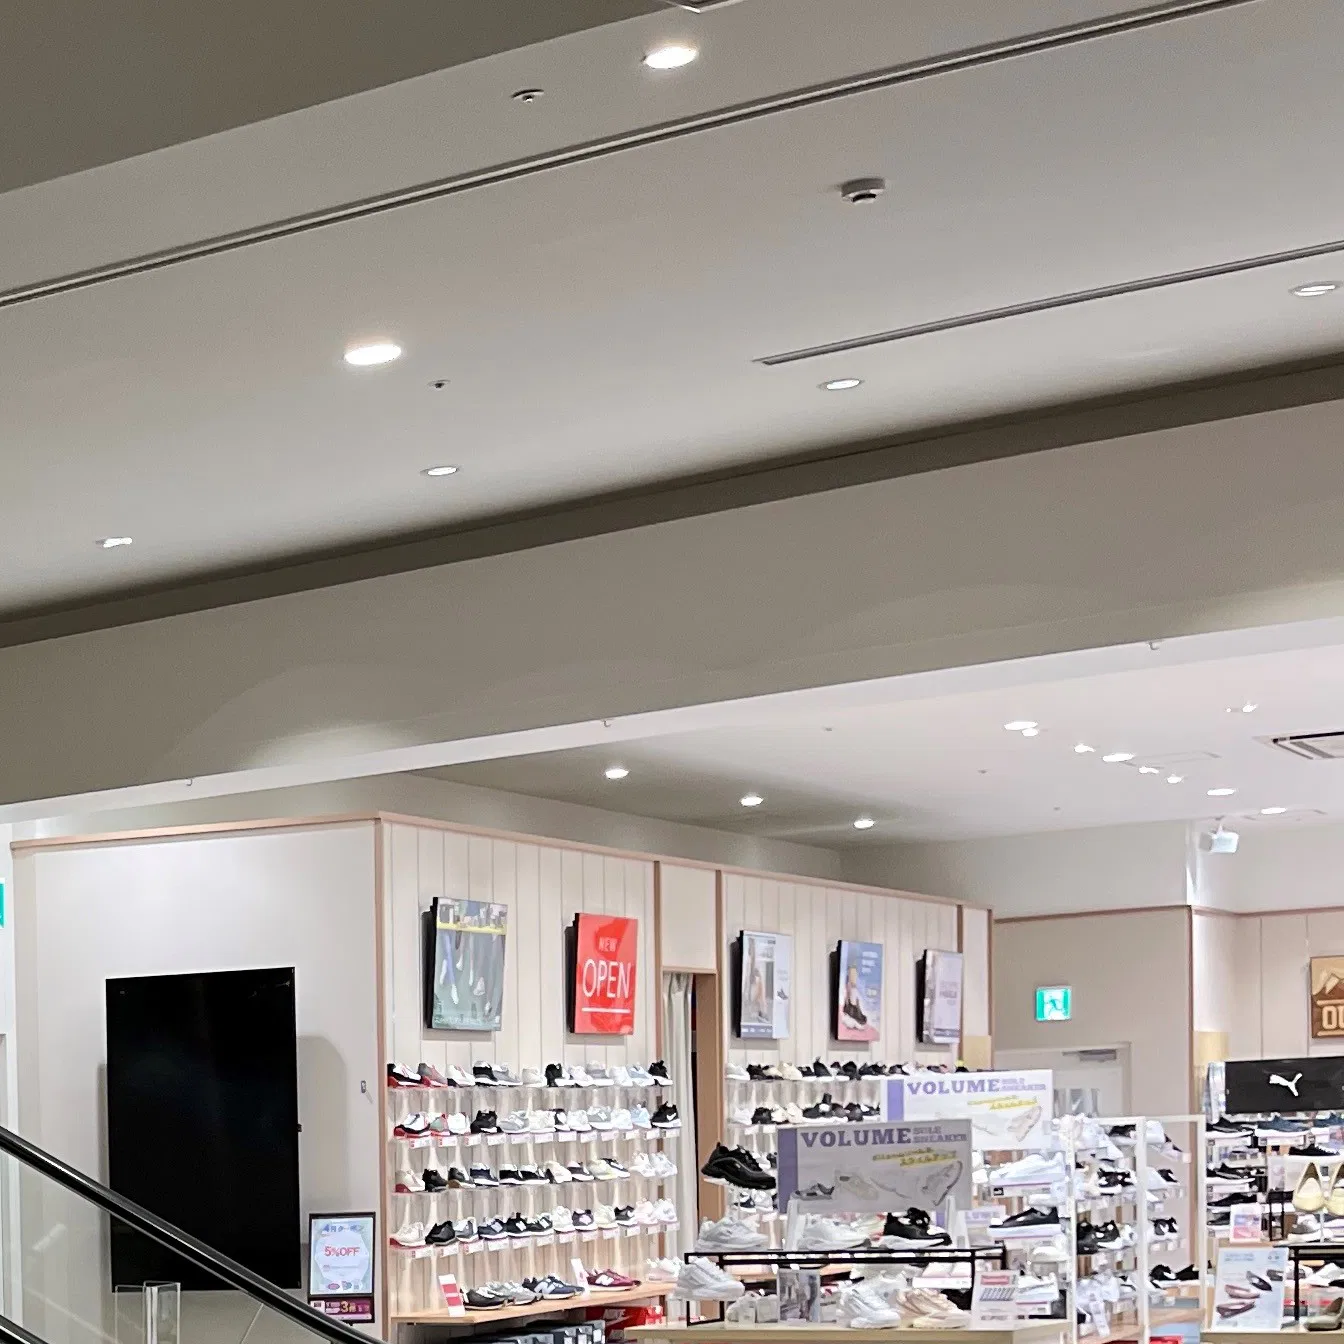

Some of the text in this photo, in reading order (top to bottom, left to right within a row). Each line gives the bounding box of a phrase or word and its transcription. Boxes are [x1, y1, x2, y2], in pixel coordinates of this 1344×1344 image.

[582, 958, 631, 999] OPEN
[907, 1079, 1001, 1095] VOLUME
[801, 1128, 911, 1148] VOLUME
[325, 1246, 360, 1257] 5%OFF
